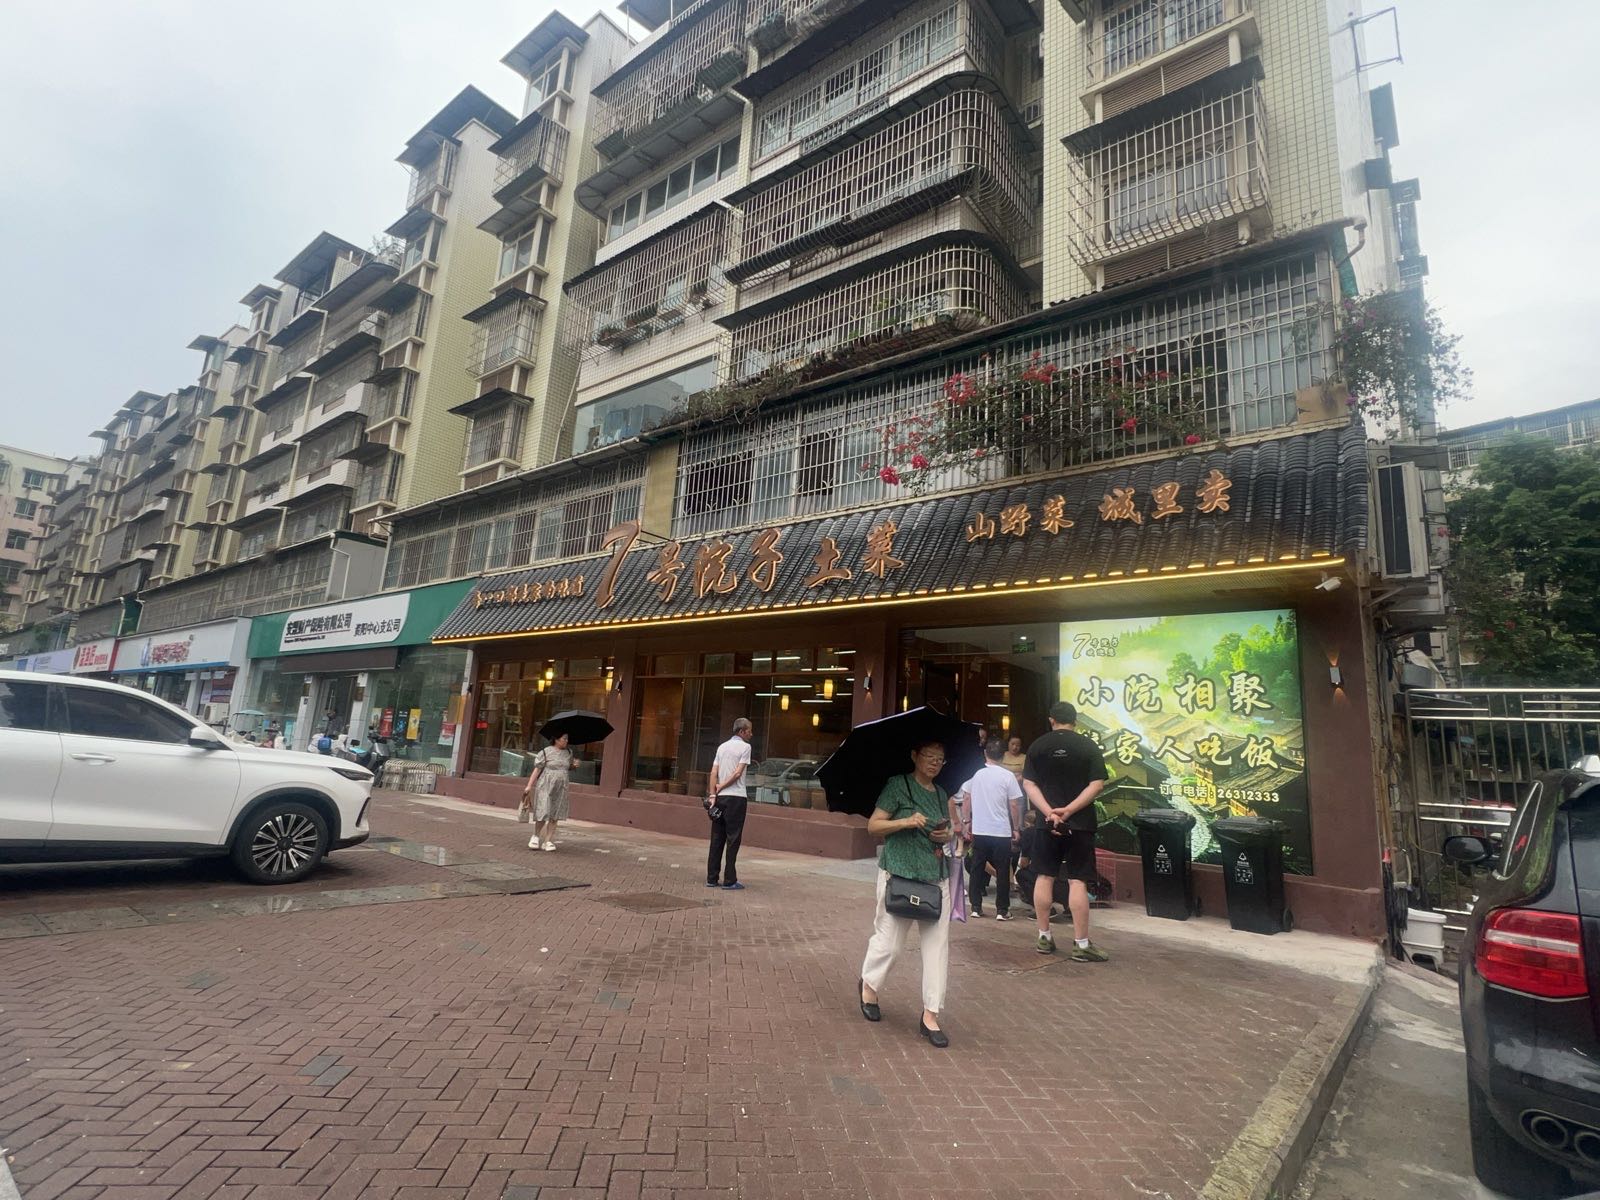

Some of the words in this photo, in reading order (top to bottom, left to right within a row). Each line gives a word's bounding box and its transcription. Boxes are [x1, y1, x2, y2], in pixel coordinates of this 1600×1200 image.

[966, 494, 1074, 543] 山野菜
[1098, 470, 1233, 524] 城里卖
[1077, 671, 1274, 716] 小院相聚
